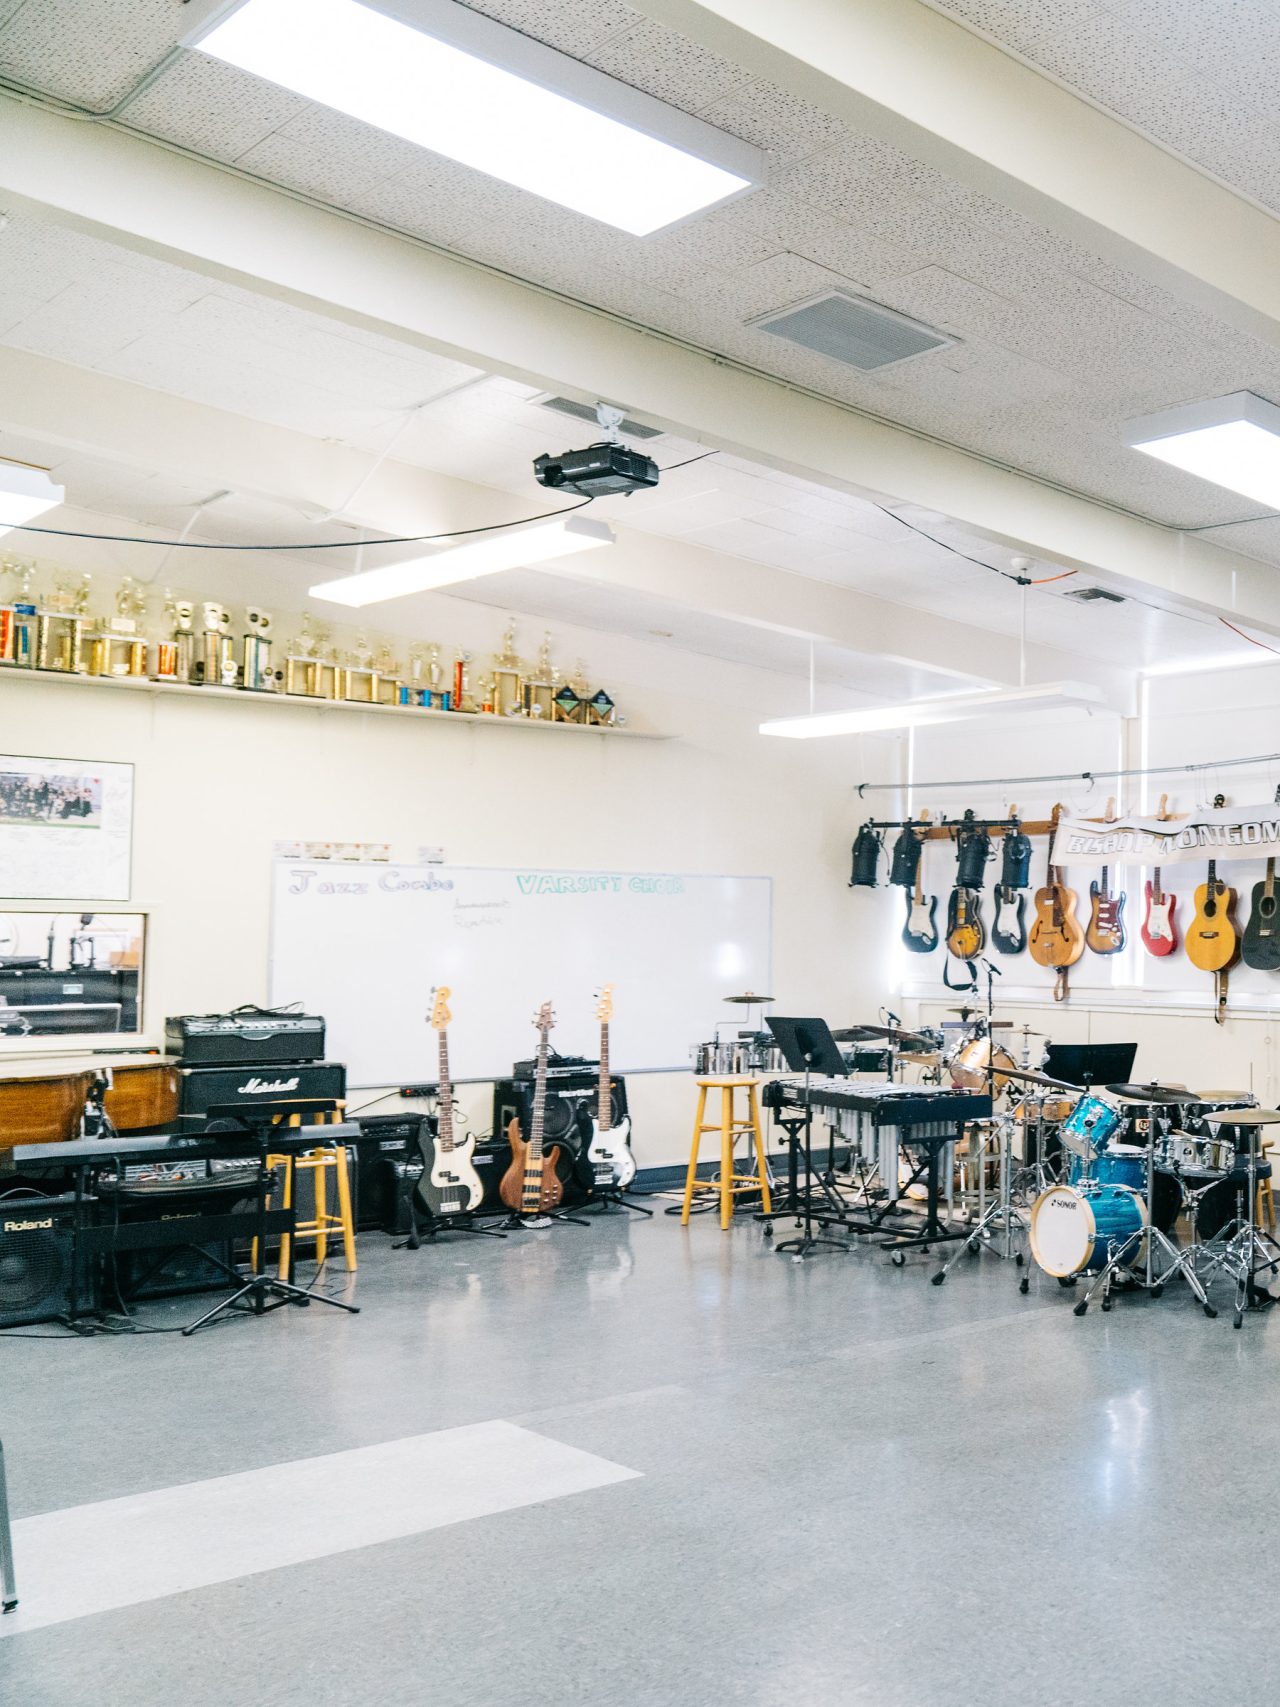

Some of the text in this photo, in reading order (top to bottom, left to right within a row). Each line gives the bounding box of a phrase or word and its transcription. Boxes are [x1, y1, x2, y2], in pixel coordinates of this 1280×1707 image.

[1065, 831, 1152, 855] BISHOP
[288, 869, 455, 895] Jazz Combo
[516, 874, 624, 896] VARSITY
[237, 1077, 300, 1094] Marshall
[1056, 1199, 1078, 1211] SONOR
[4, 1217, 53, 1232] Roland
